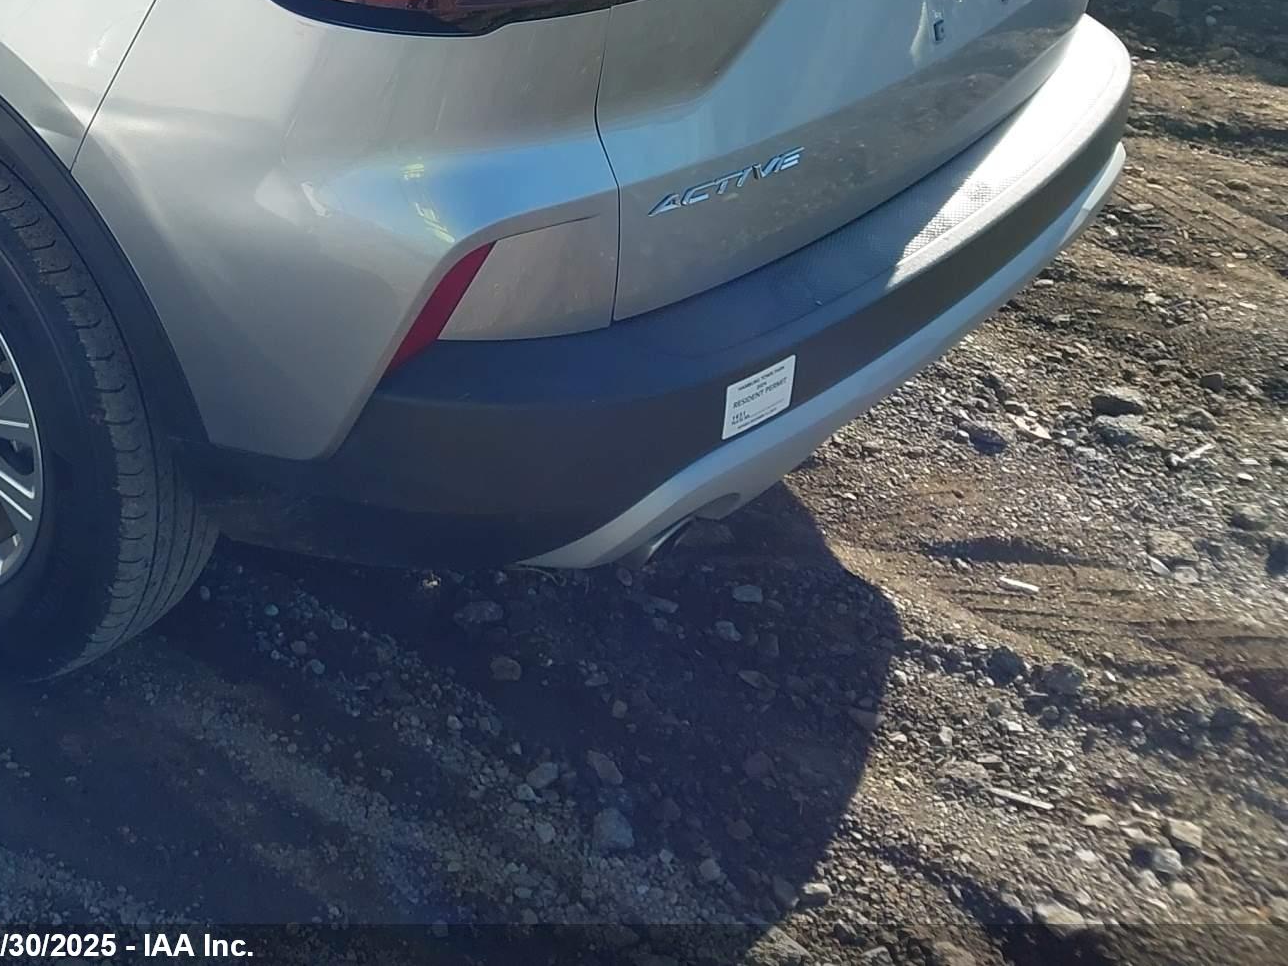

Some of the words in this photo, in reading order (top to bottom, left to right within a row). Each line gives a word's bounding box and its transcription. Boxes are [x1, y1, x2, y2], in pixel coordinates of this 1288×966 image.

[648, 146, 805, 217] ACTIVE
[733, 389, 764, 409] RESIDENT
[765, 377, 788, 394] PERMIT
